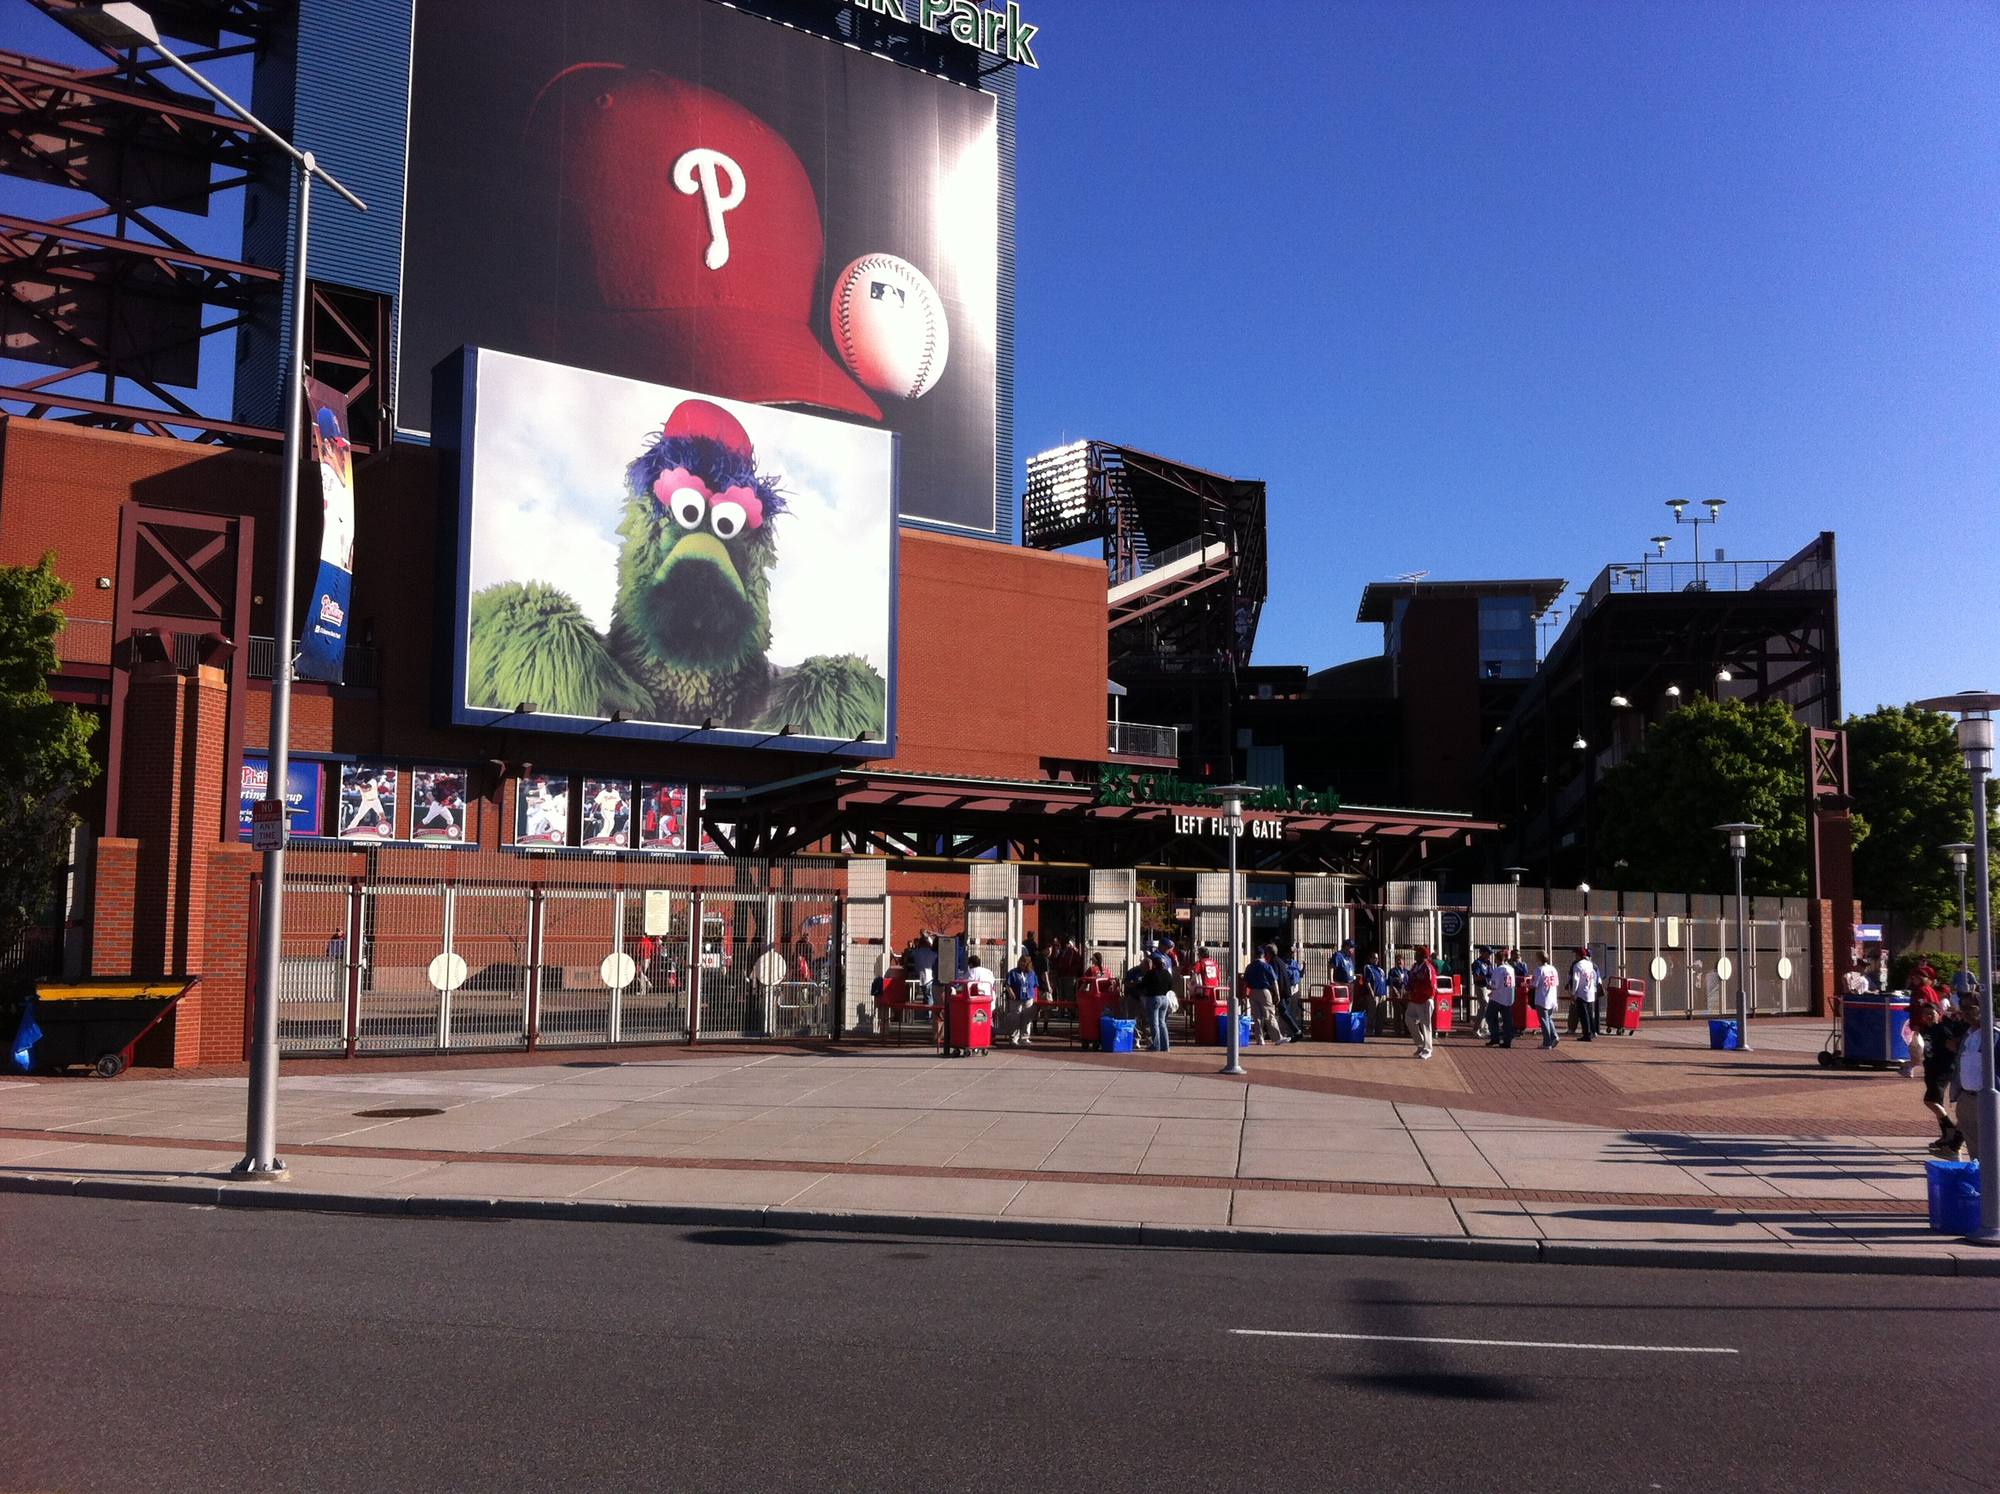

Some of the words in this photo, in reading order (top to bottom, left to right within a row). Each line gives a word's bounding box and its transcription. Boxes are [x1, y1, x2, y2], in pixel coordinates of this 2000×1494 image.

[673, 147, 746, 270] P
[261, 802, 273, 813] NO
[258, 822, 275, 830] ANY
[1175, 814, 1204, 835] LEFT
[1252, 820, 1282, 840] GATE
[258, 831, 277, 840] TIME
